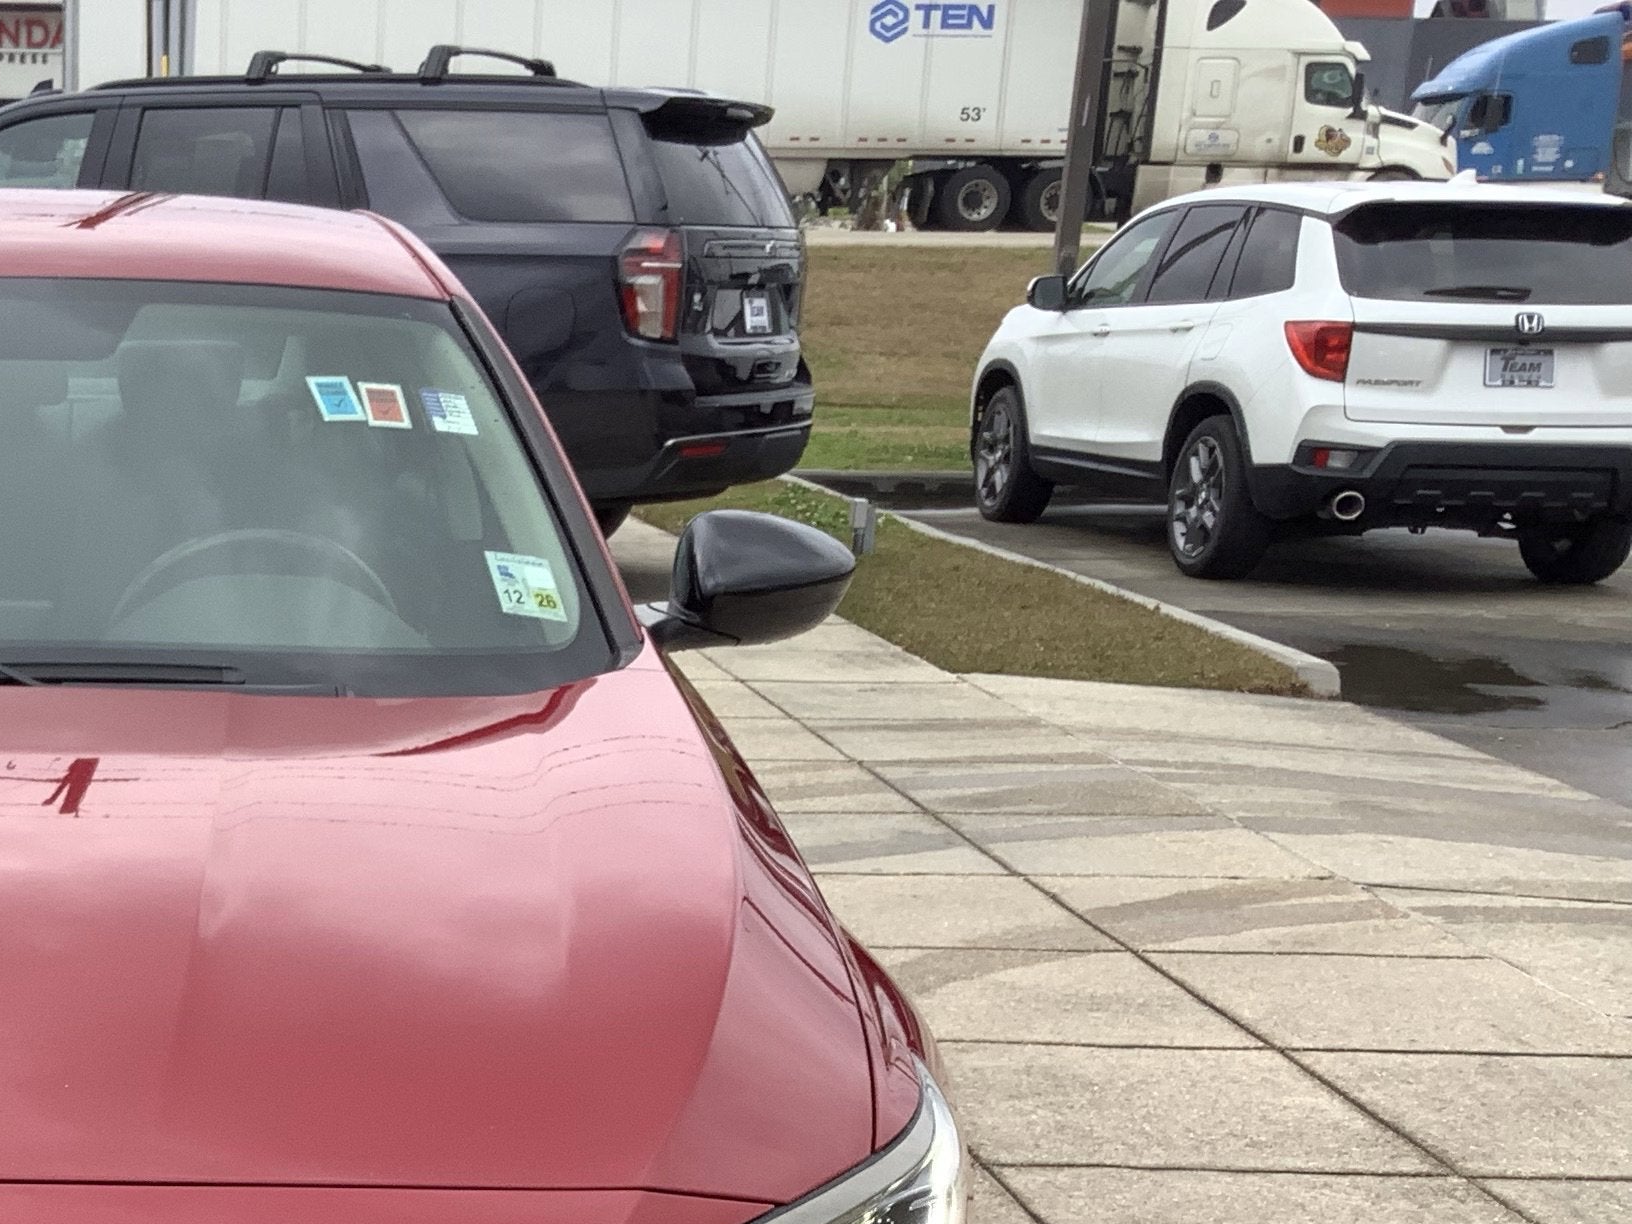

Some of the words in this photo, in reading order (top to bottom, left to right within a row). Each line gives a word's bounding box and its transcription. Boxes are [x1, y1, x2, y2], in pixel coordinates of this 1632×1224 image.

[914, 4, 995, 30] TEN
[503, 589, 525, 604] 12
[534, 593, 557, 609] 26
